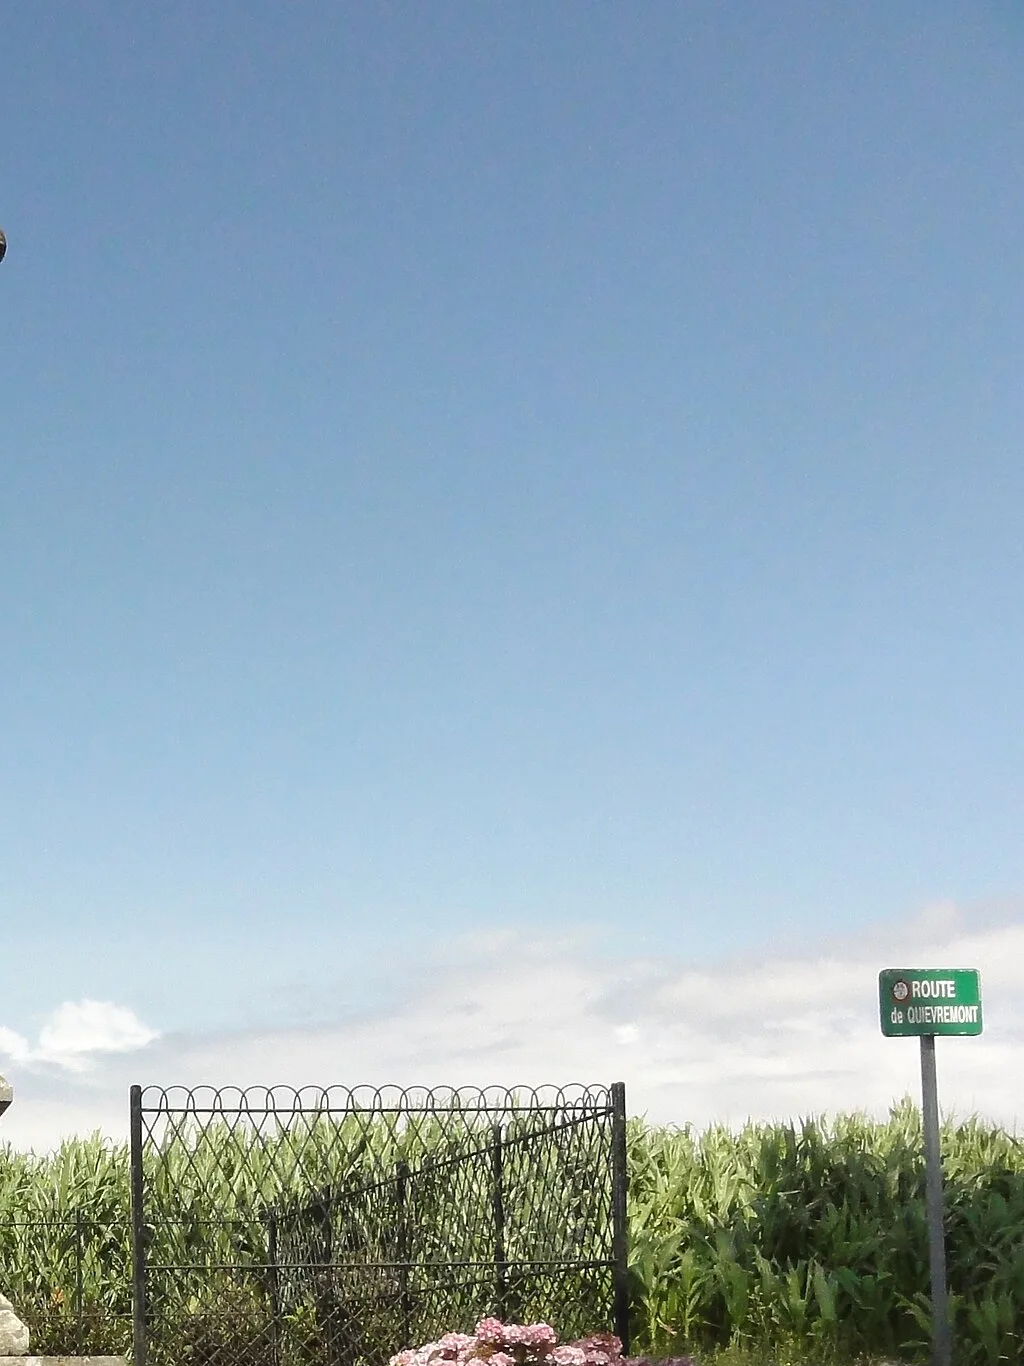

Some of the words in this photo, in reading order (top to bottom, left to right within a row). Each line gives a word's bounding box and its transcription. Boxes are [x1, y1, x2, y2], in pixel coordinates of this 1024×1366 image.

[911, 980, 956, 998] ROUTE
[890, 1007, 903, 1024] de
[907, 1005, 978, 1024] QUIEVREMONT
